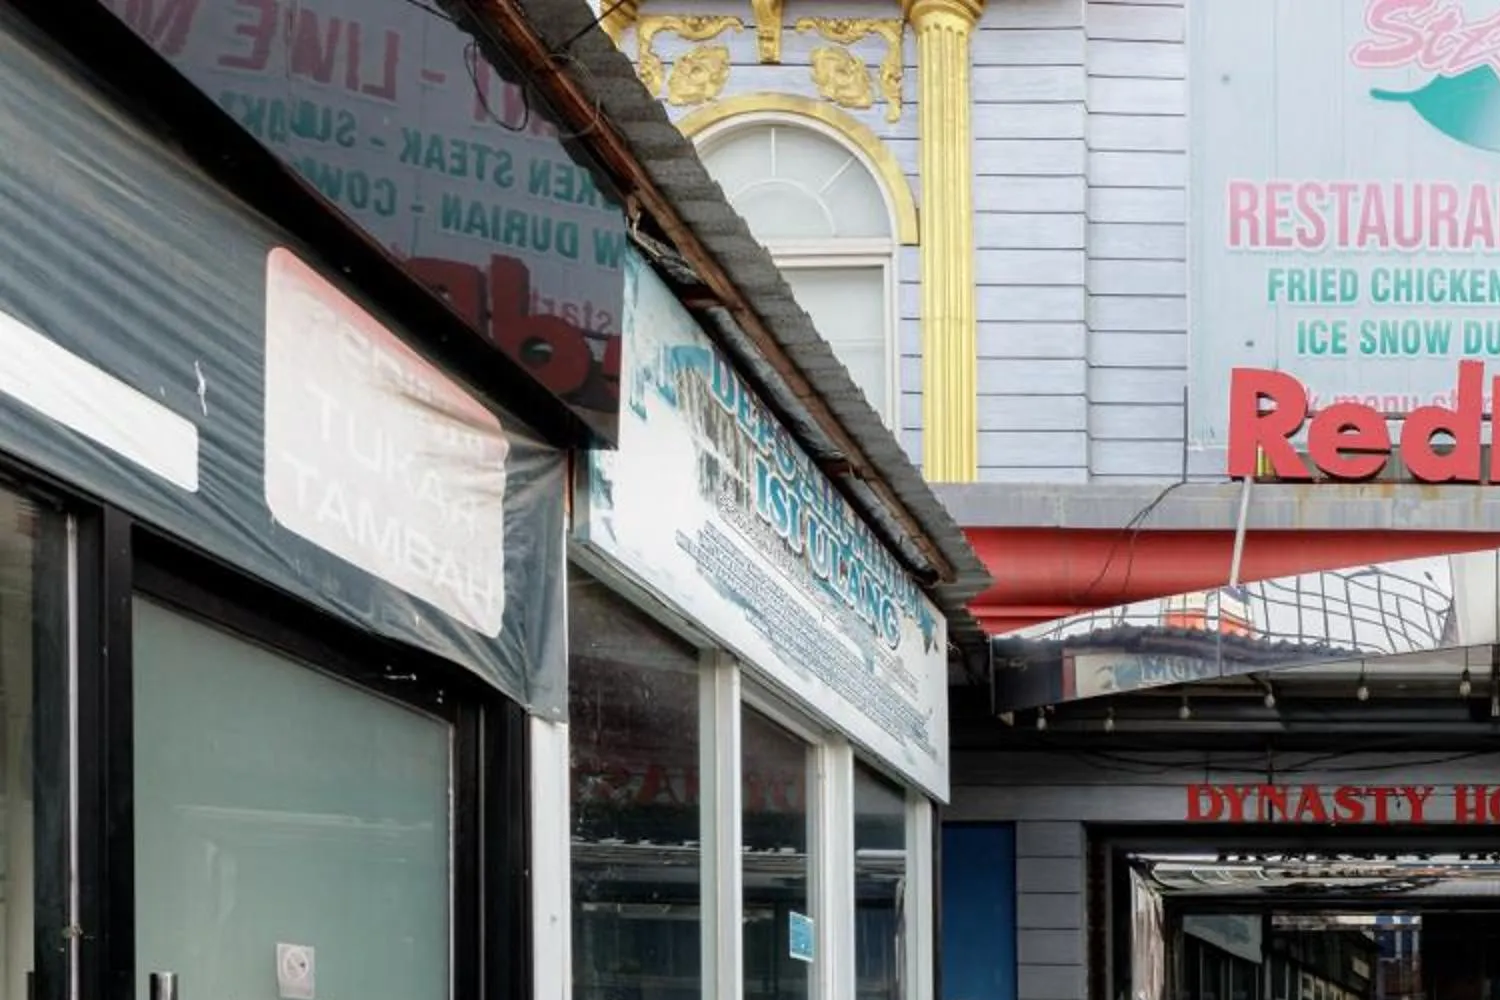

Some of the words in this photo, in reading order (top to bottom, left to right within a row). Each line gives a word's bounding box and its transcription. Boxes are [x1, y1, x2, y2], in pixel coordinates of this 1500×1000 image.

[1267, 268, 1360, 305] FRIED
[1296, 320, 1348, 357] ICE
[1359, 320, 1453, 357] SNOW
[755, 454, 803, 555] ISI
[806, 509, 901, 651] ULANG
[1186, 784, 1435, 824] DYNASTY
